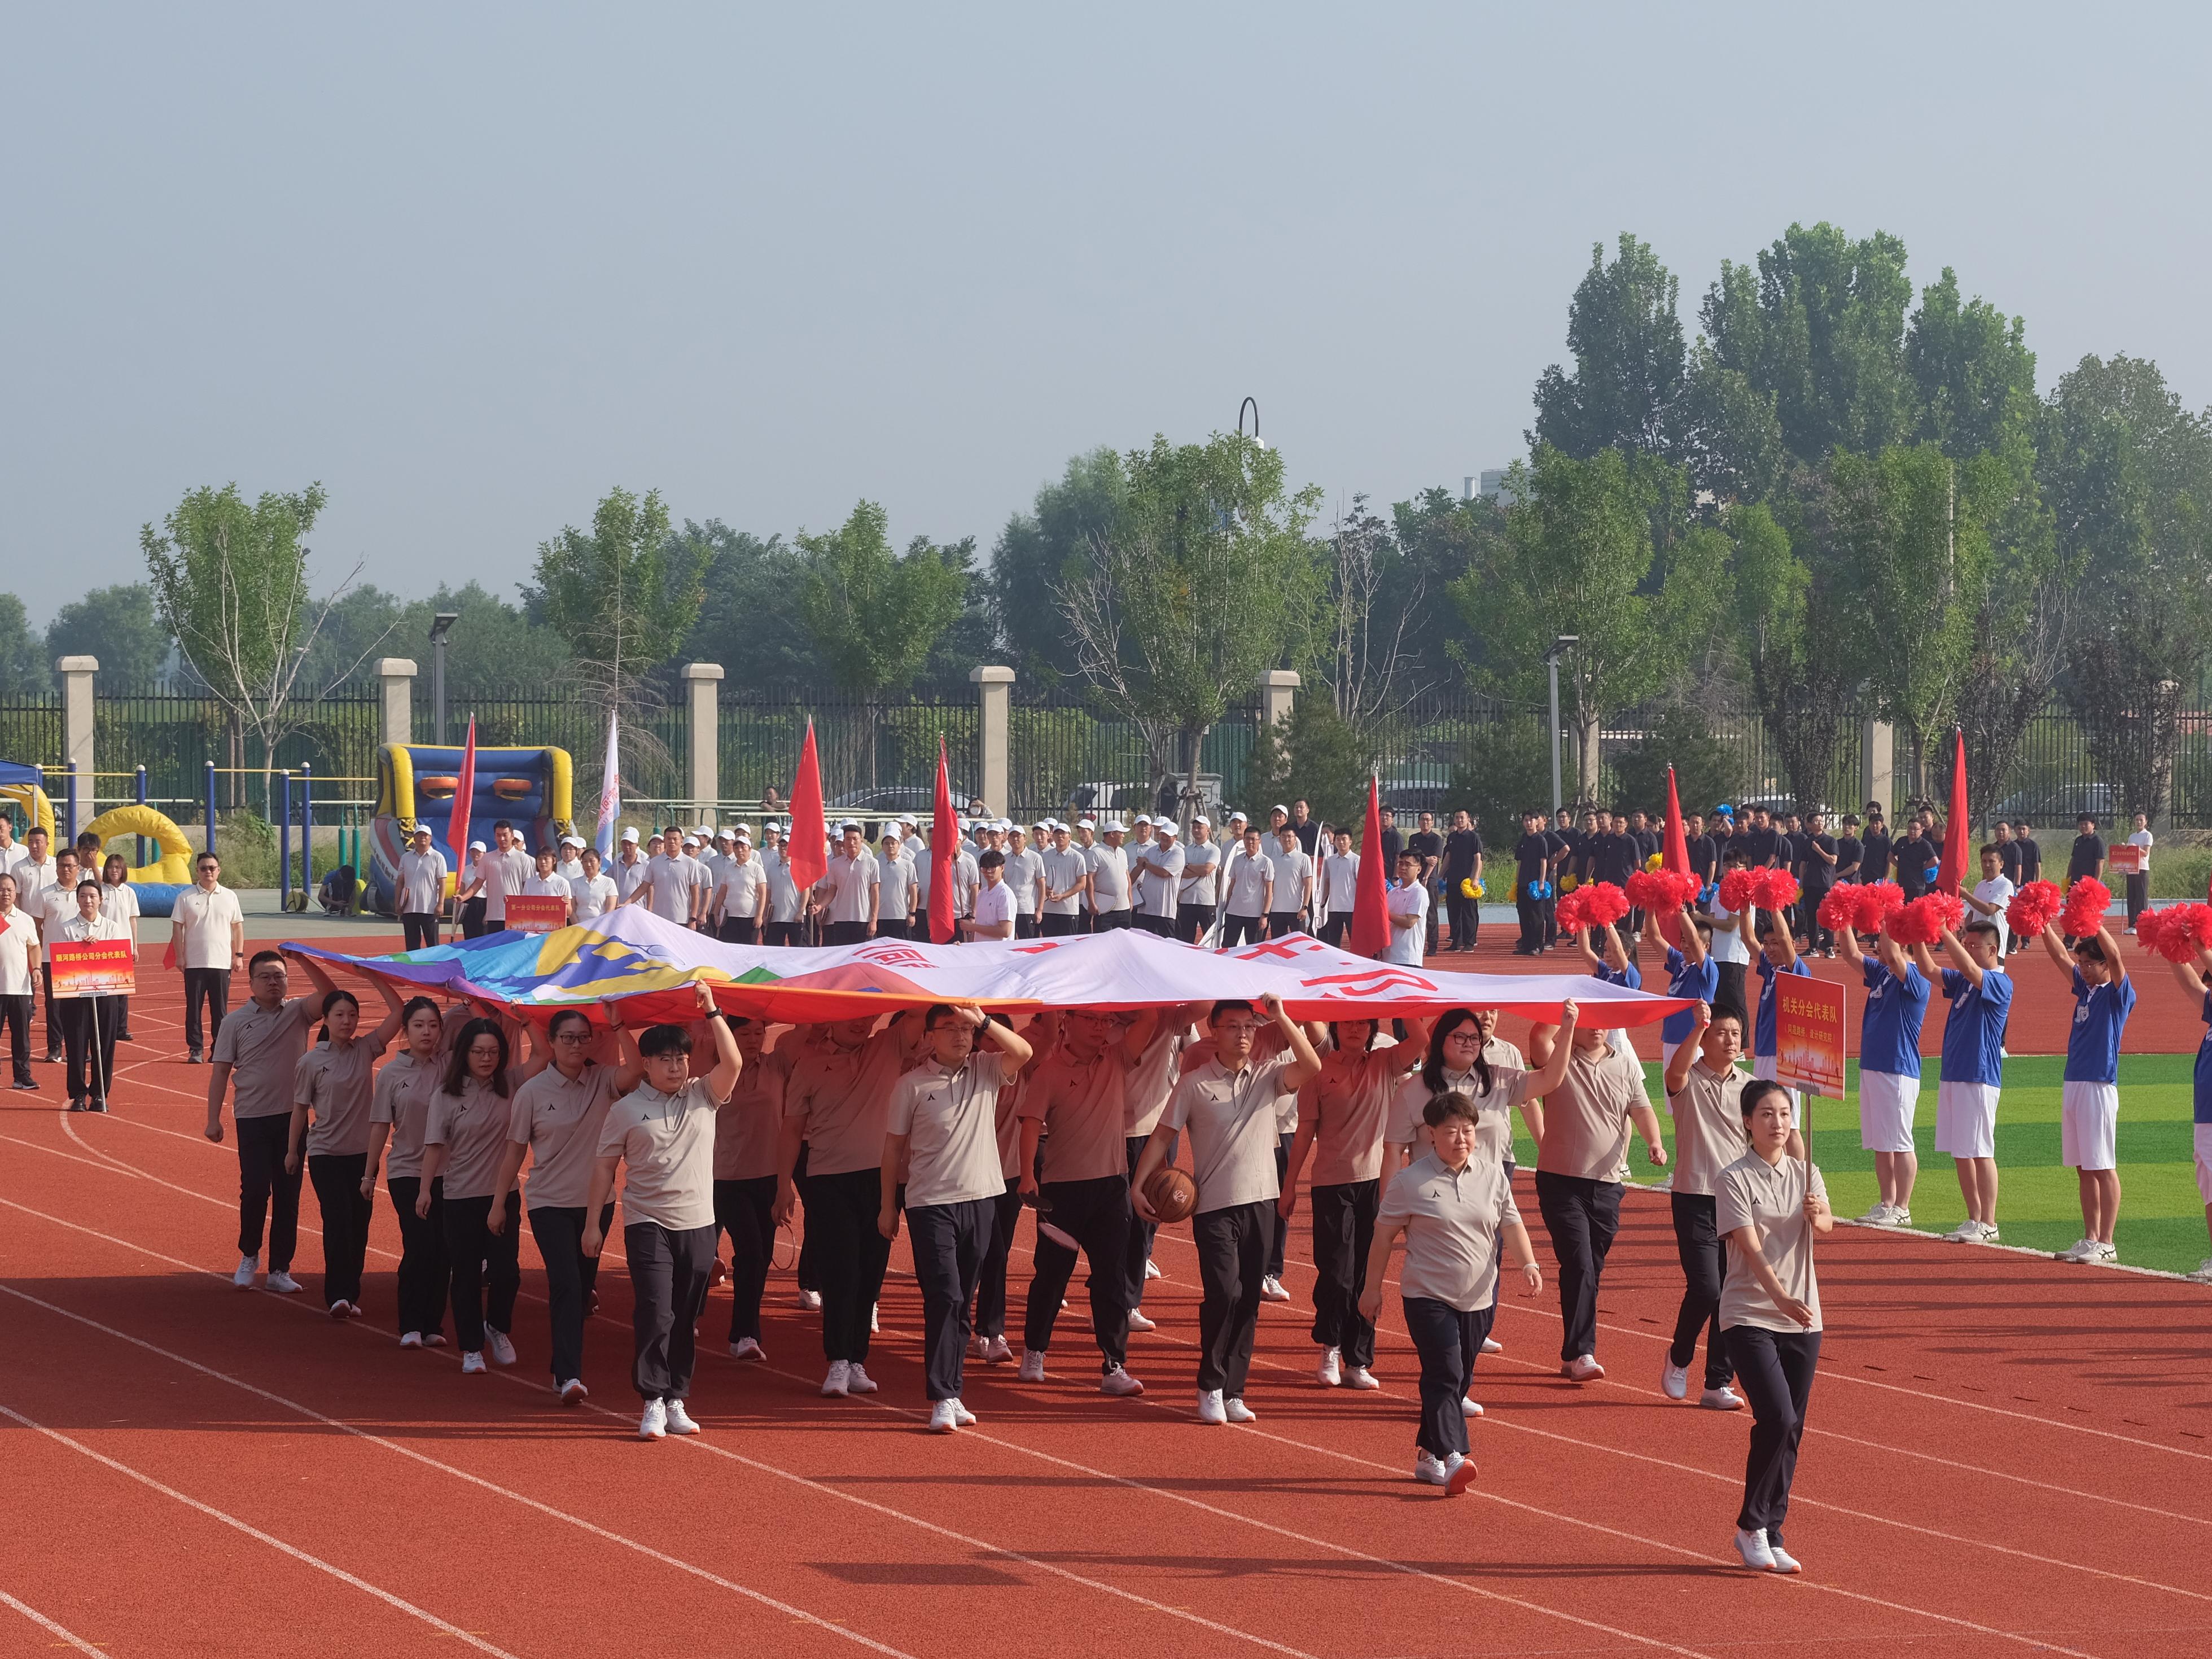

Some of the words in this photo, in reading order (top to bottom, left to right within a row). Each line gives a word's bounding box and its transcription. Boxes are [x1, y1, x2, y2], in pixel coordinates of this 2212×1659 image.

[1782, 996, 1837, 1023] 机关分会代表队
